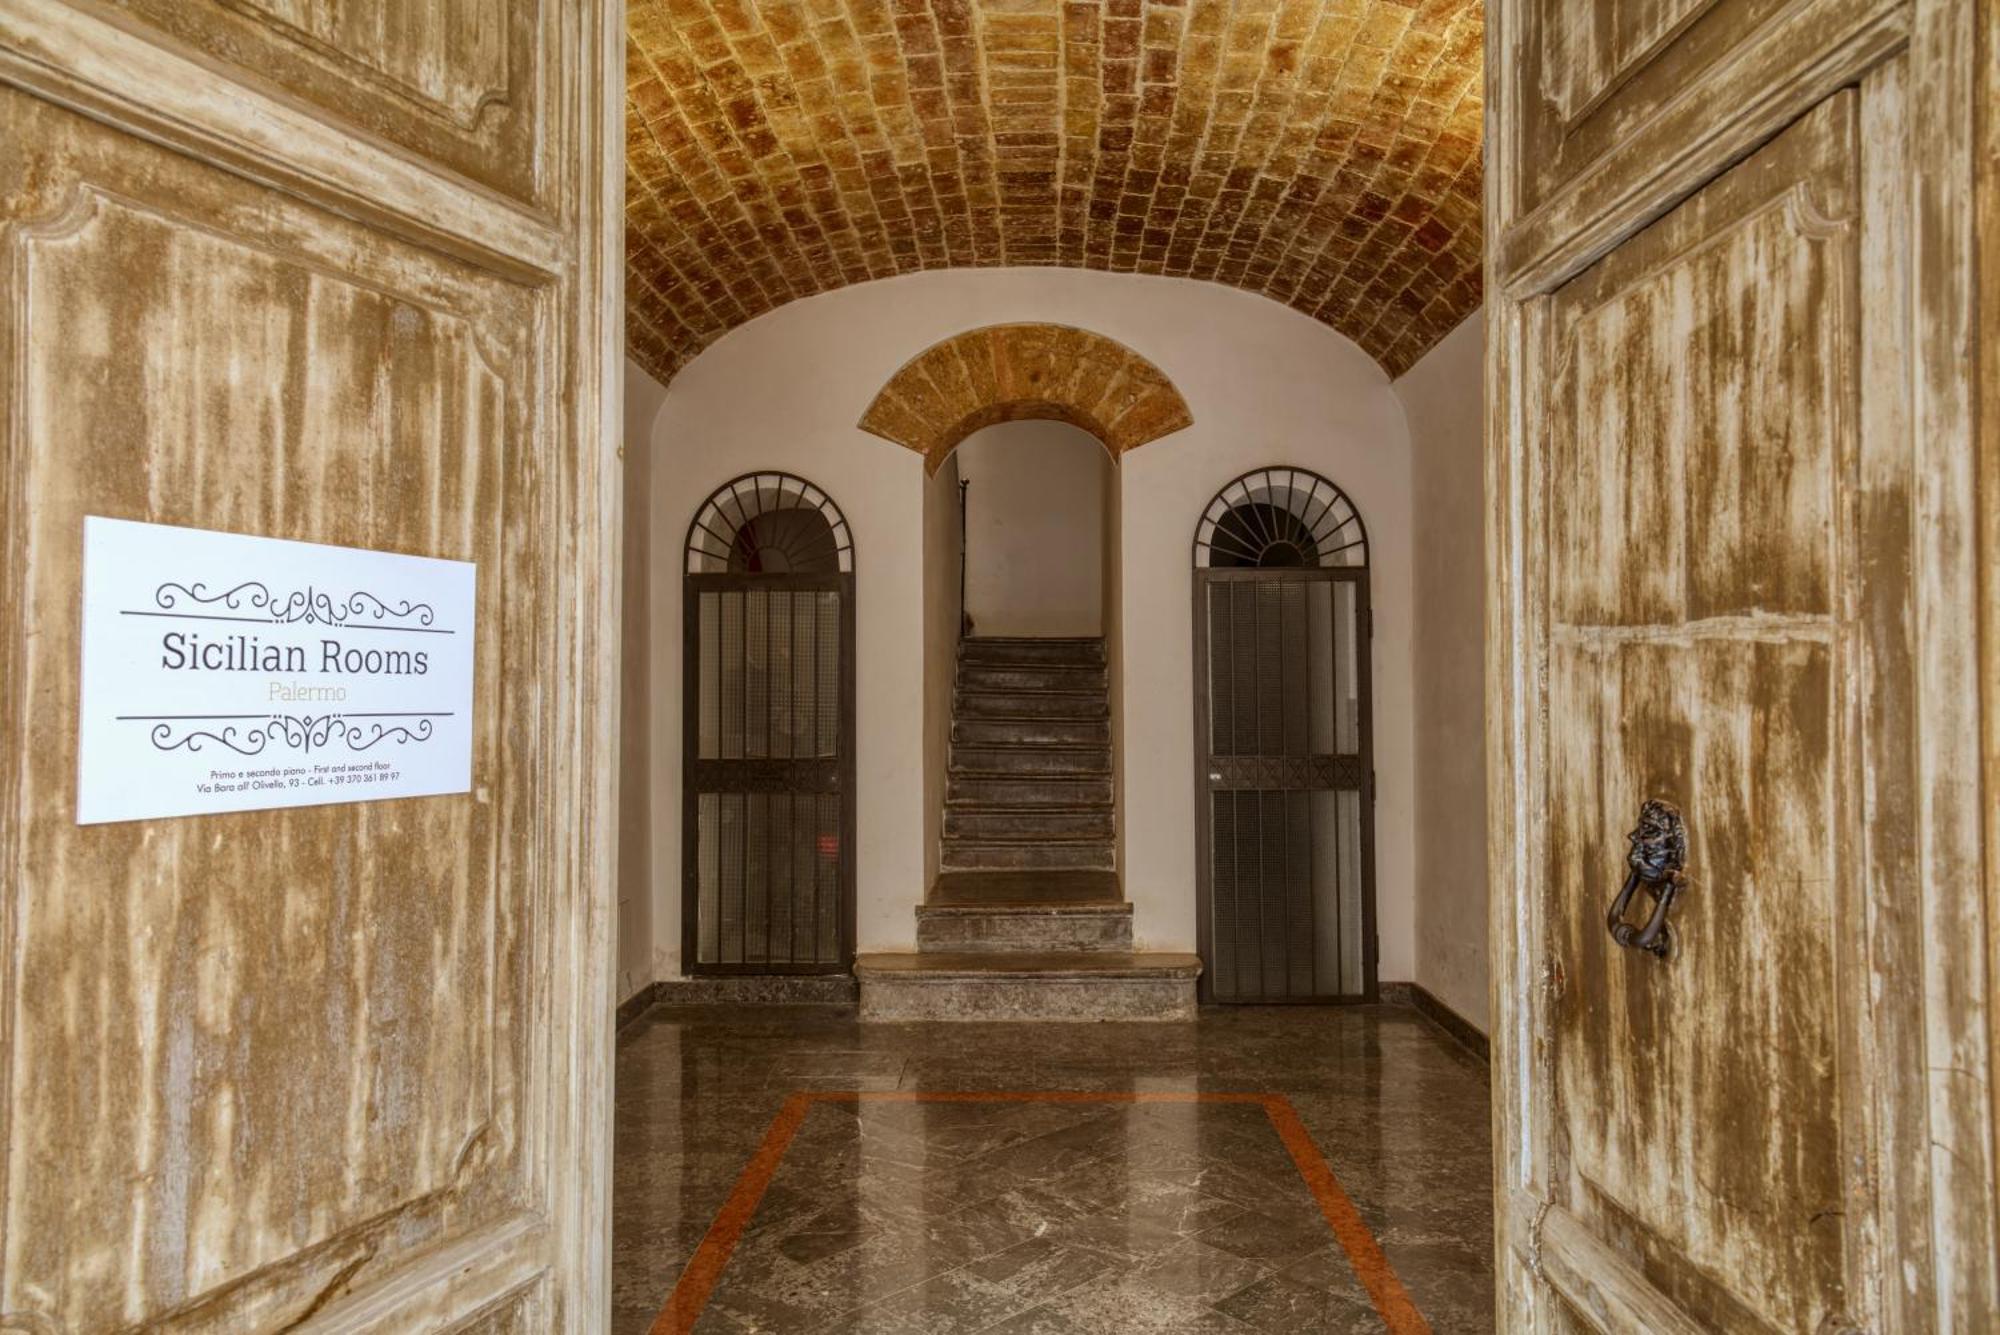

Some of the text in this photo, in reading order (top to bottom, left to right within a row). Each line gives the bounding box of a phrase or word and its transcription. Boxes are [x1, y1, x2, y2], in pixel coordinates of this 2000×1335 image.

[162, 631, 428, 675] Sicilian Rooms
[269, 681, 346, 701] Palermo
[210, 770, 236, 780] Primo
[246, 768, 281, 778] secondo
[283, 767, 306, 777] piano
[314, 764, 329, 774] First
[331, 763, 346, 773] and
[347, 762, 373, 772] second
[374, 761, 390, 770] floor
[196, 784, 212, 793] Via
[288, 778, 300, 788] 93
[329, 775, 345, 785] +39
[347, 774, 361, 784] 370
[391, 771, 399, 780] 97
